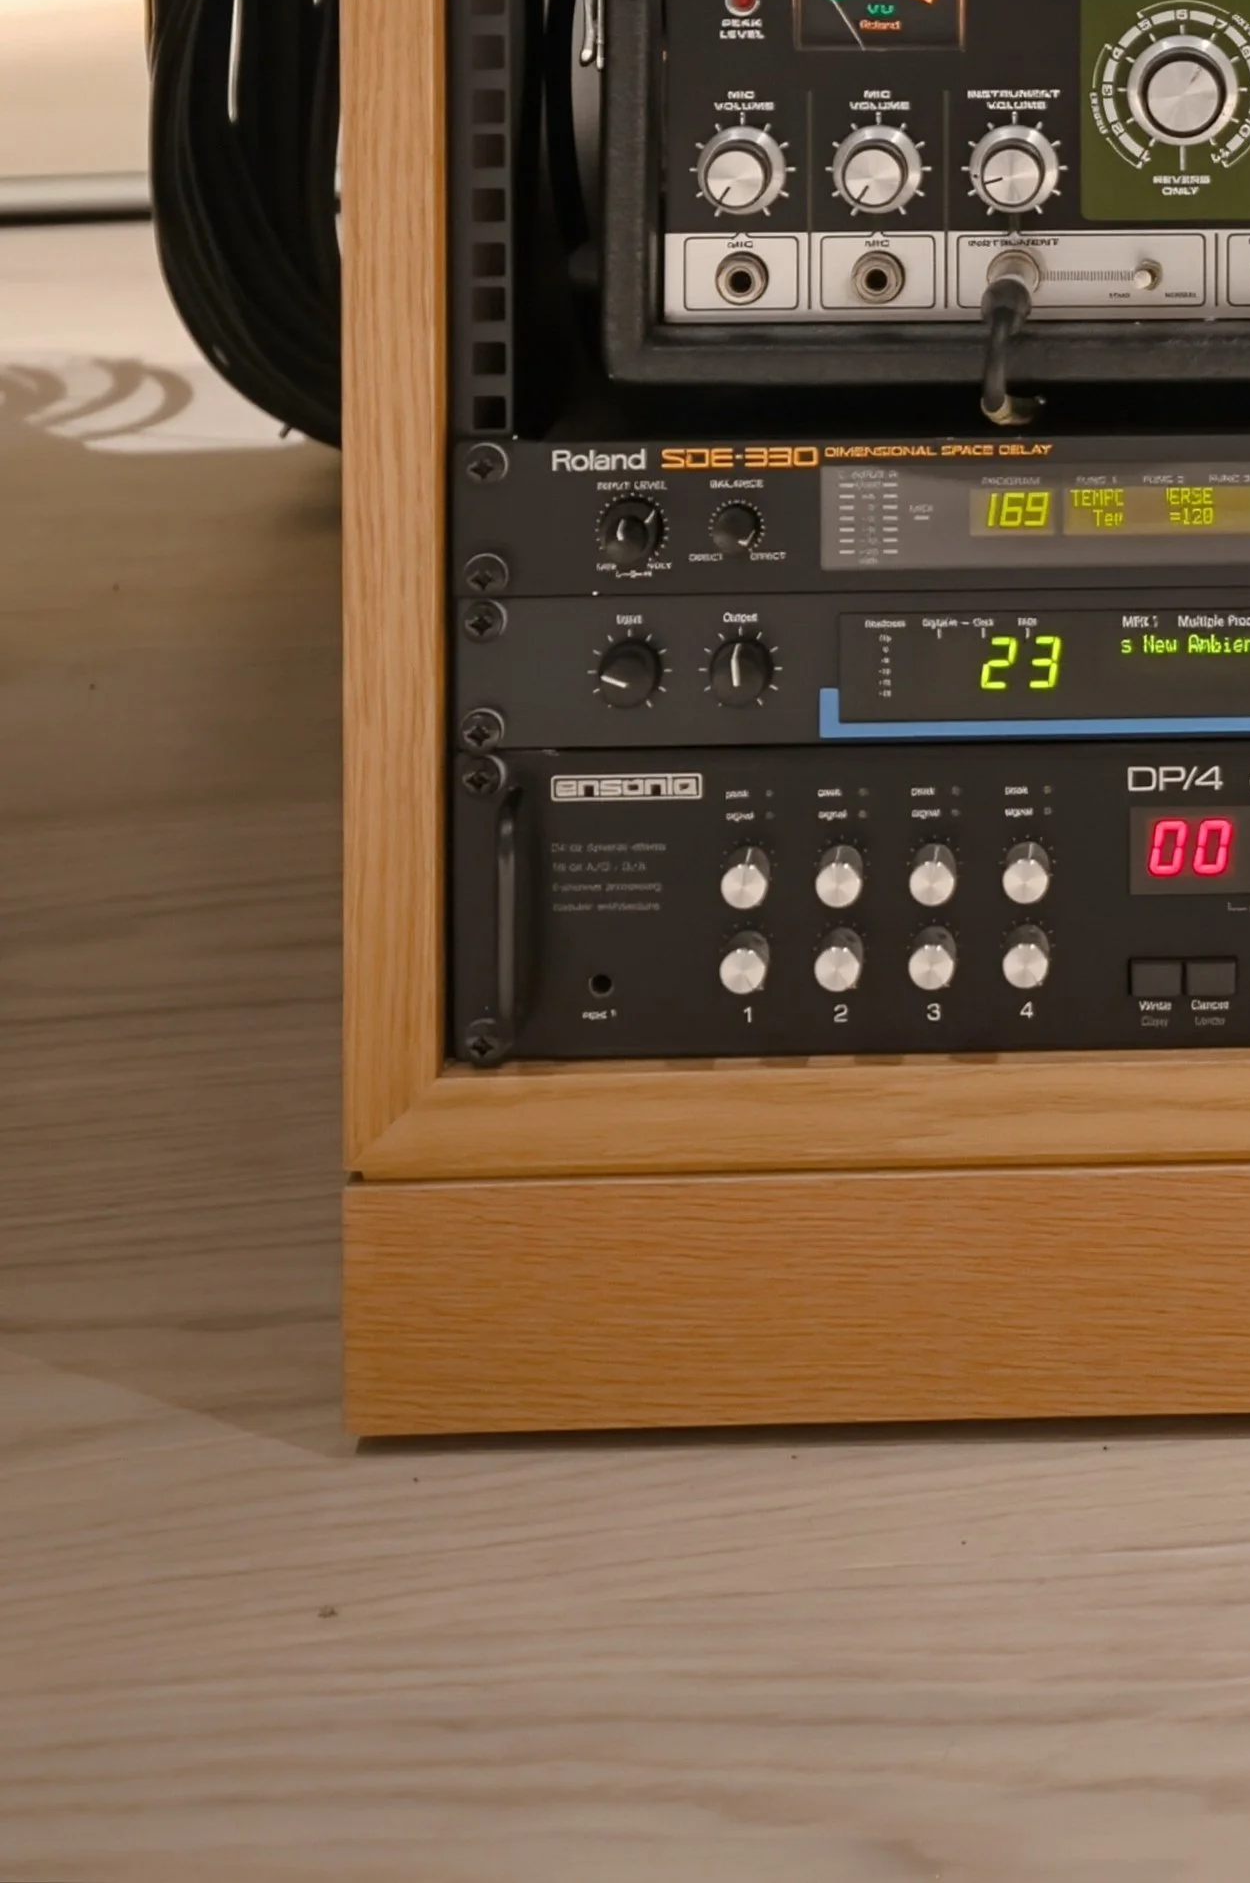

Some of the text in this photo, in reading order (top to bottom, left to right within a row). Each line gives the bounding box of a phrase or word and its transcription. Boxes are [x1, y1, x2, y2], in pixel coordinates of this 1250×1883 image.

[722, 19, 763, 28] PEAK
[719, 30, 765, 40] LEVEL
[966, 90, 1061, 99] INSTRUMENT
[714, 102, 775, 111] VOLUME
[849, 101, 911, 110] VOLUME
[986, 101, 1046, 110] VOLUME
[1161, 186, 1199, 196] ONLY
[551, 443, 1053, 471] Roland SDE-330 DIMENSIONAL SPACE DELAY
[634, 480, 667, 490] LEVEL
[709, 479, 764, 489] BALANCE
[986, 491, 1050, 528] 169
[1177, 614, 1224, 628] Multiple
[1120, 639, 1132, 654] s
[1143, 635, 1178, 654] New
[981, 636, 1062, 690] 23
[1127, 765, 1224, 792] DP/4
[555, 776, 699, 799] ensoniq
[1147, 818, 1233, 877] 00
[743, 1007, 753, 1023] 1
[833, 1005, 849, 1023] 2
[926, 1003, 942, 1021] 3
[1019, 1001, 1034, 1018] 4
